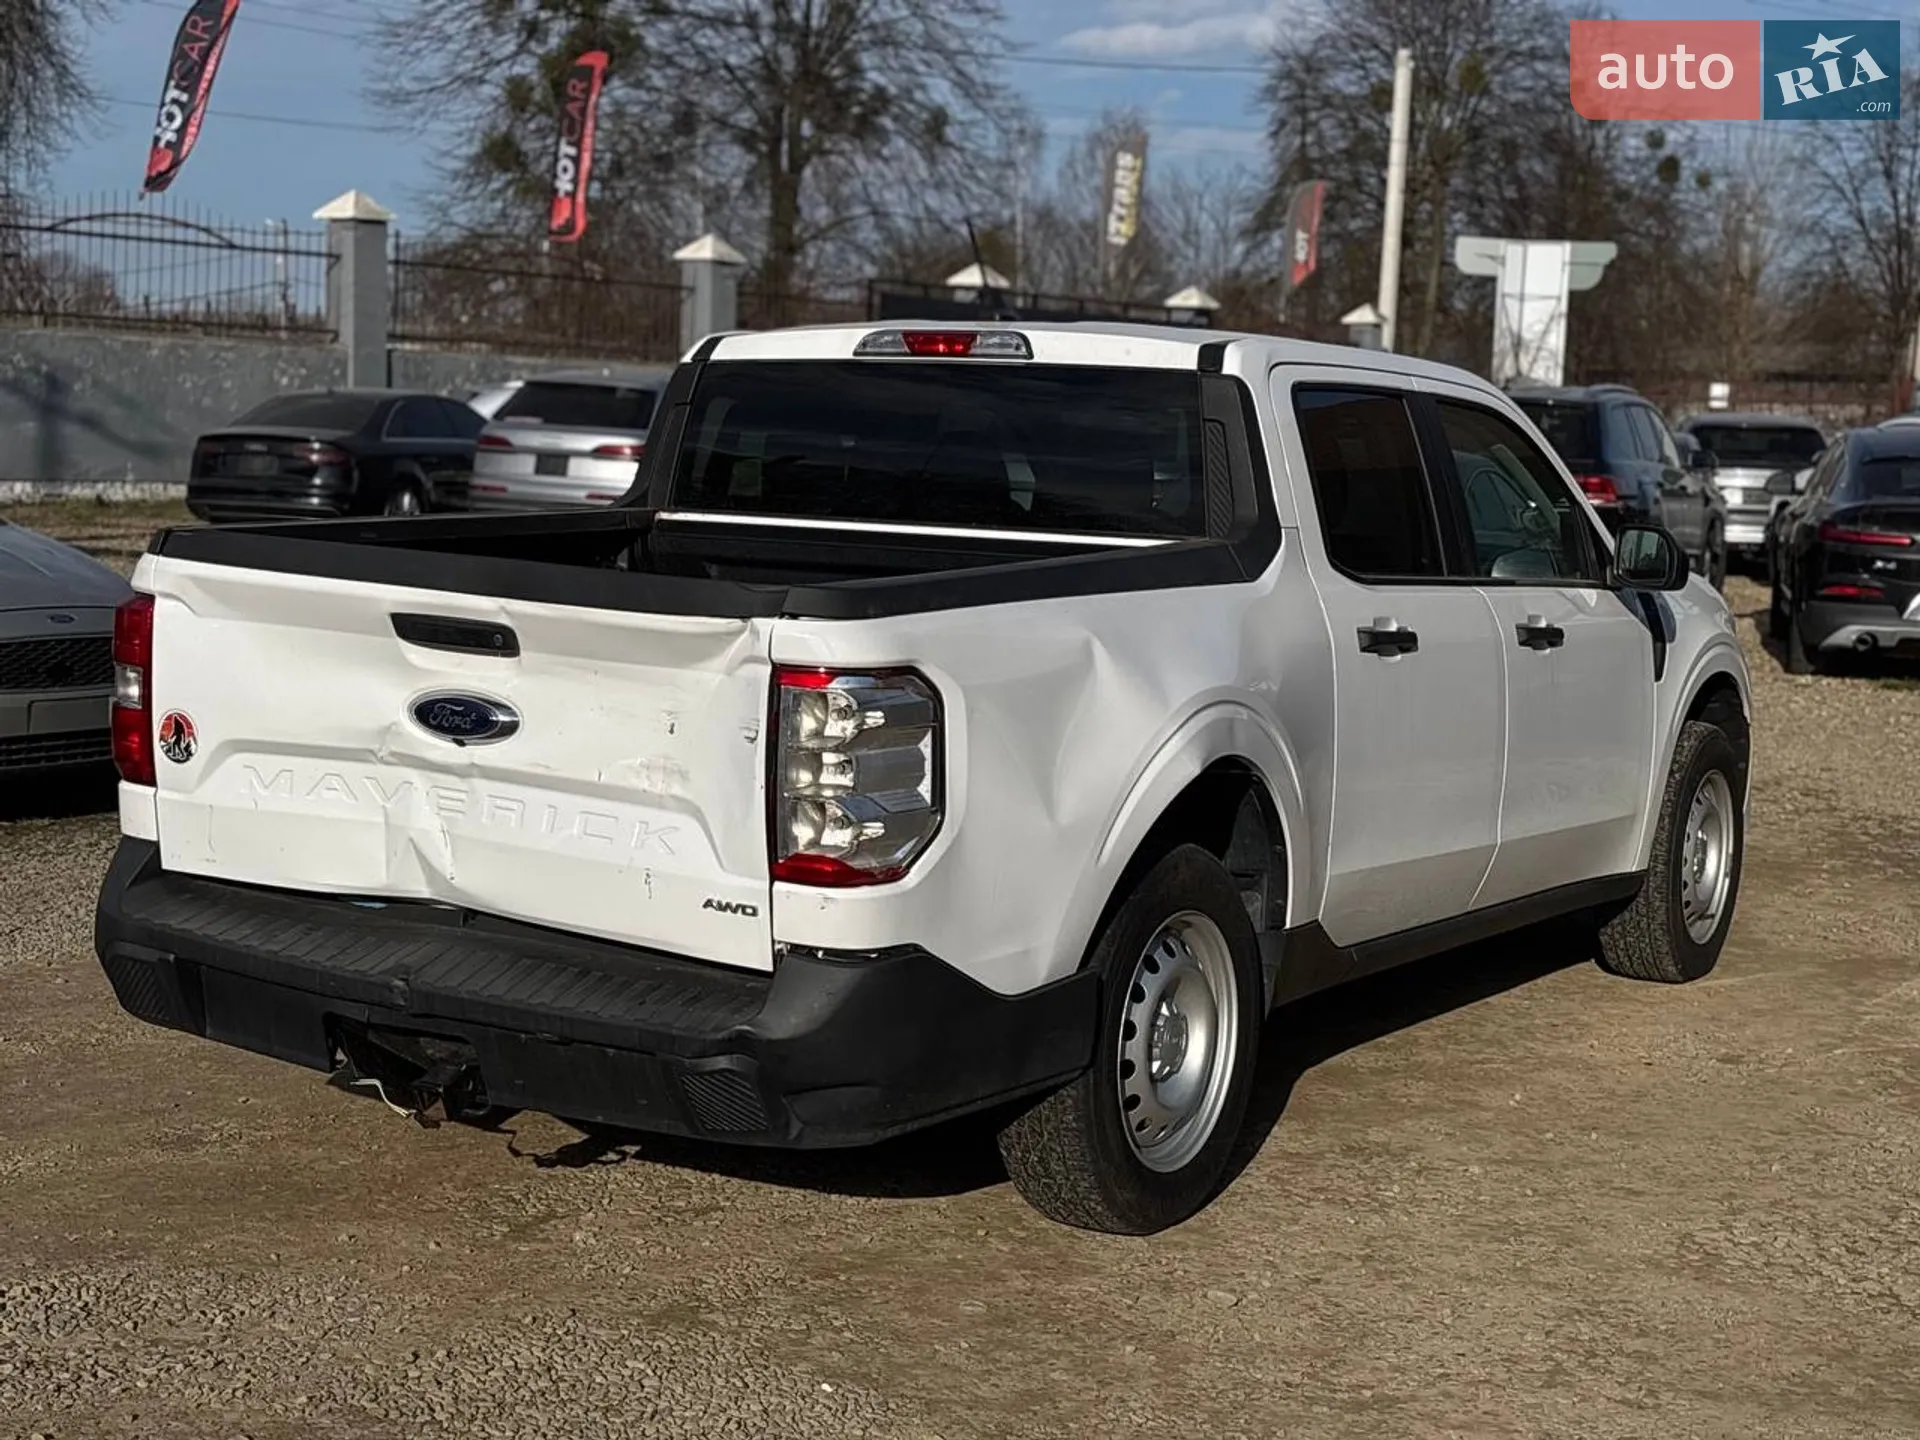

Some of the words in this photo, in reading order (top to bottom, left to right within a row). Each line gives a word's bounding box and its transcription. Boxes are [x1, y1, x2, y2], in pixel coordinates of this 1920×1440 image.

[429, 702, 478, 729] Ford
[240, 764, 681, 856] MAVERICK
[702, 898, 759, 917] AWD
